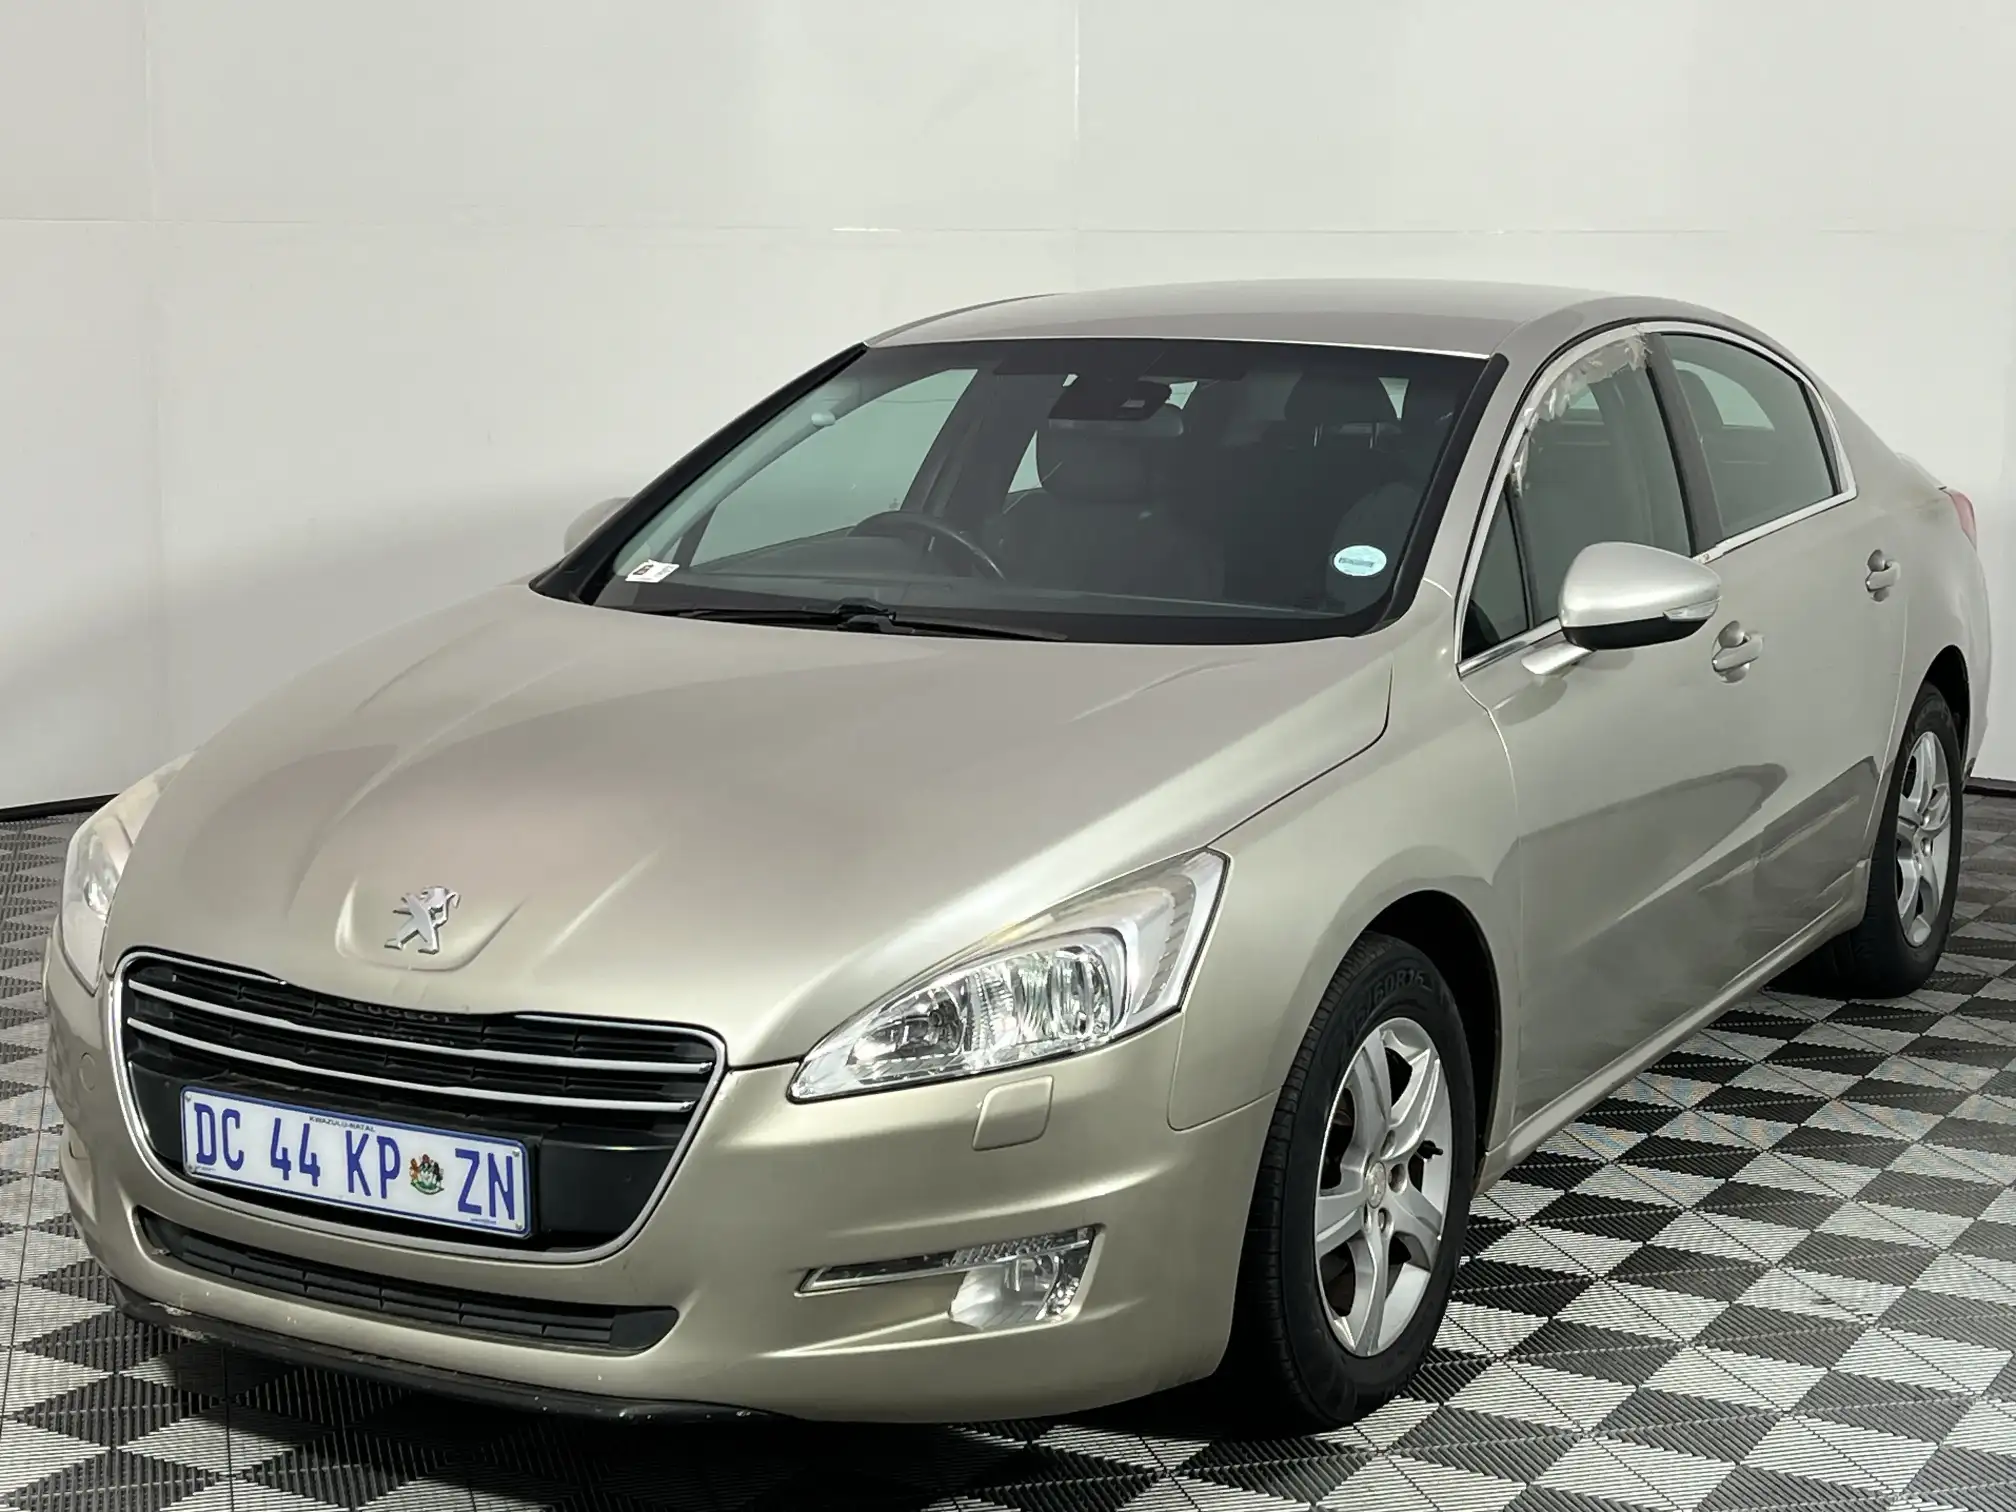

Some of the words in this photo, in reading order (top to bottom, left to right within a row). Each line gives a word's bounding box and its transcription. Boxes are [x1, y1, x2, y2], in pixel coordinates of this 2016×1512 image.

[308, 1115, 376, 1132] KWAZULU-NATAL
[194, 1102, 245, 1171] DC
[270, 1117, 321, 1187] 44
[345, 1130, 401, 1199] KP
[454, 1148, 515, 1220] ZN
